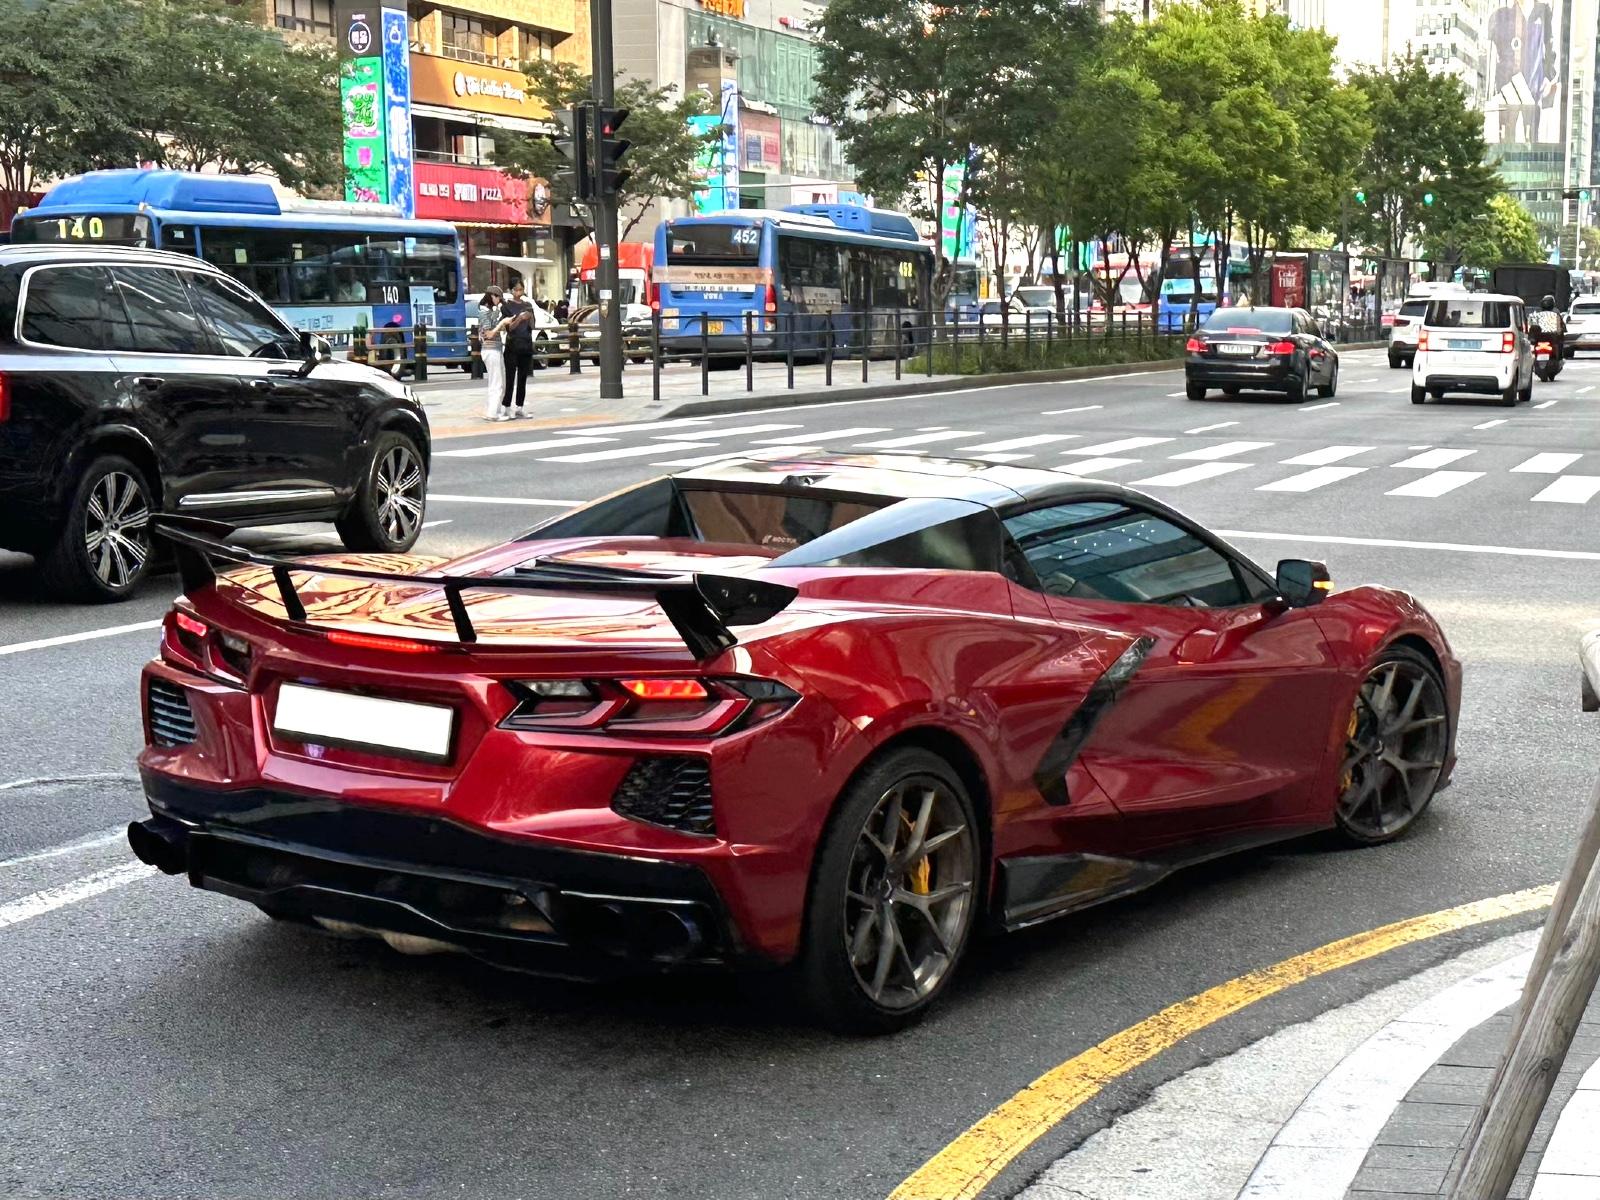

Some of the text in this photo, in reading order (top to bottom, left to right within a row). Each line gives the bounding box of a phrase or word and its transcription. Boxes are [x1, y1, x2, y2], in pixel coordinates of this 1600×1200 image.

[58, 217, 104, 239] 140
[733, 229, 757, 244] 452
[382, 285, 399, 305] 140
